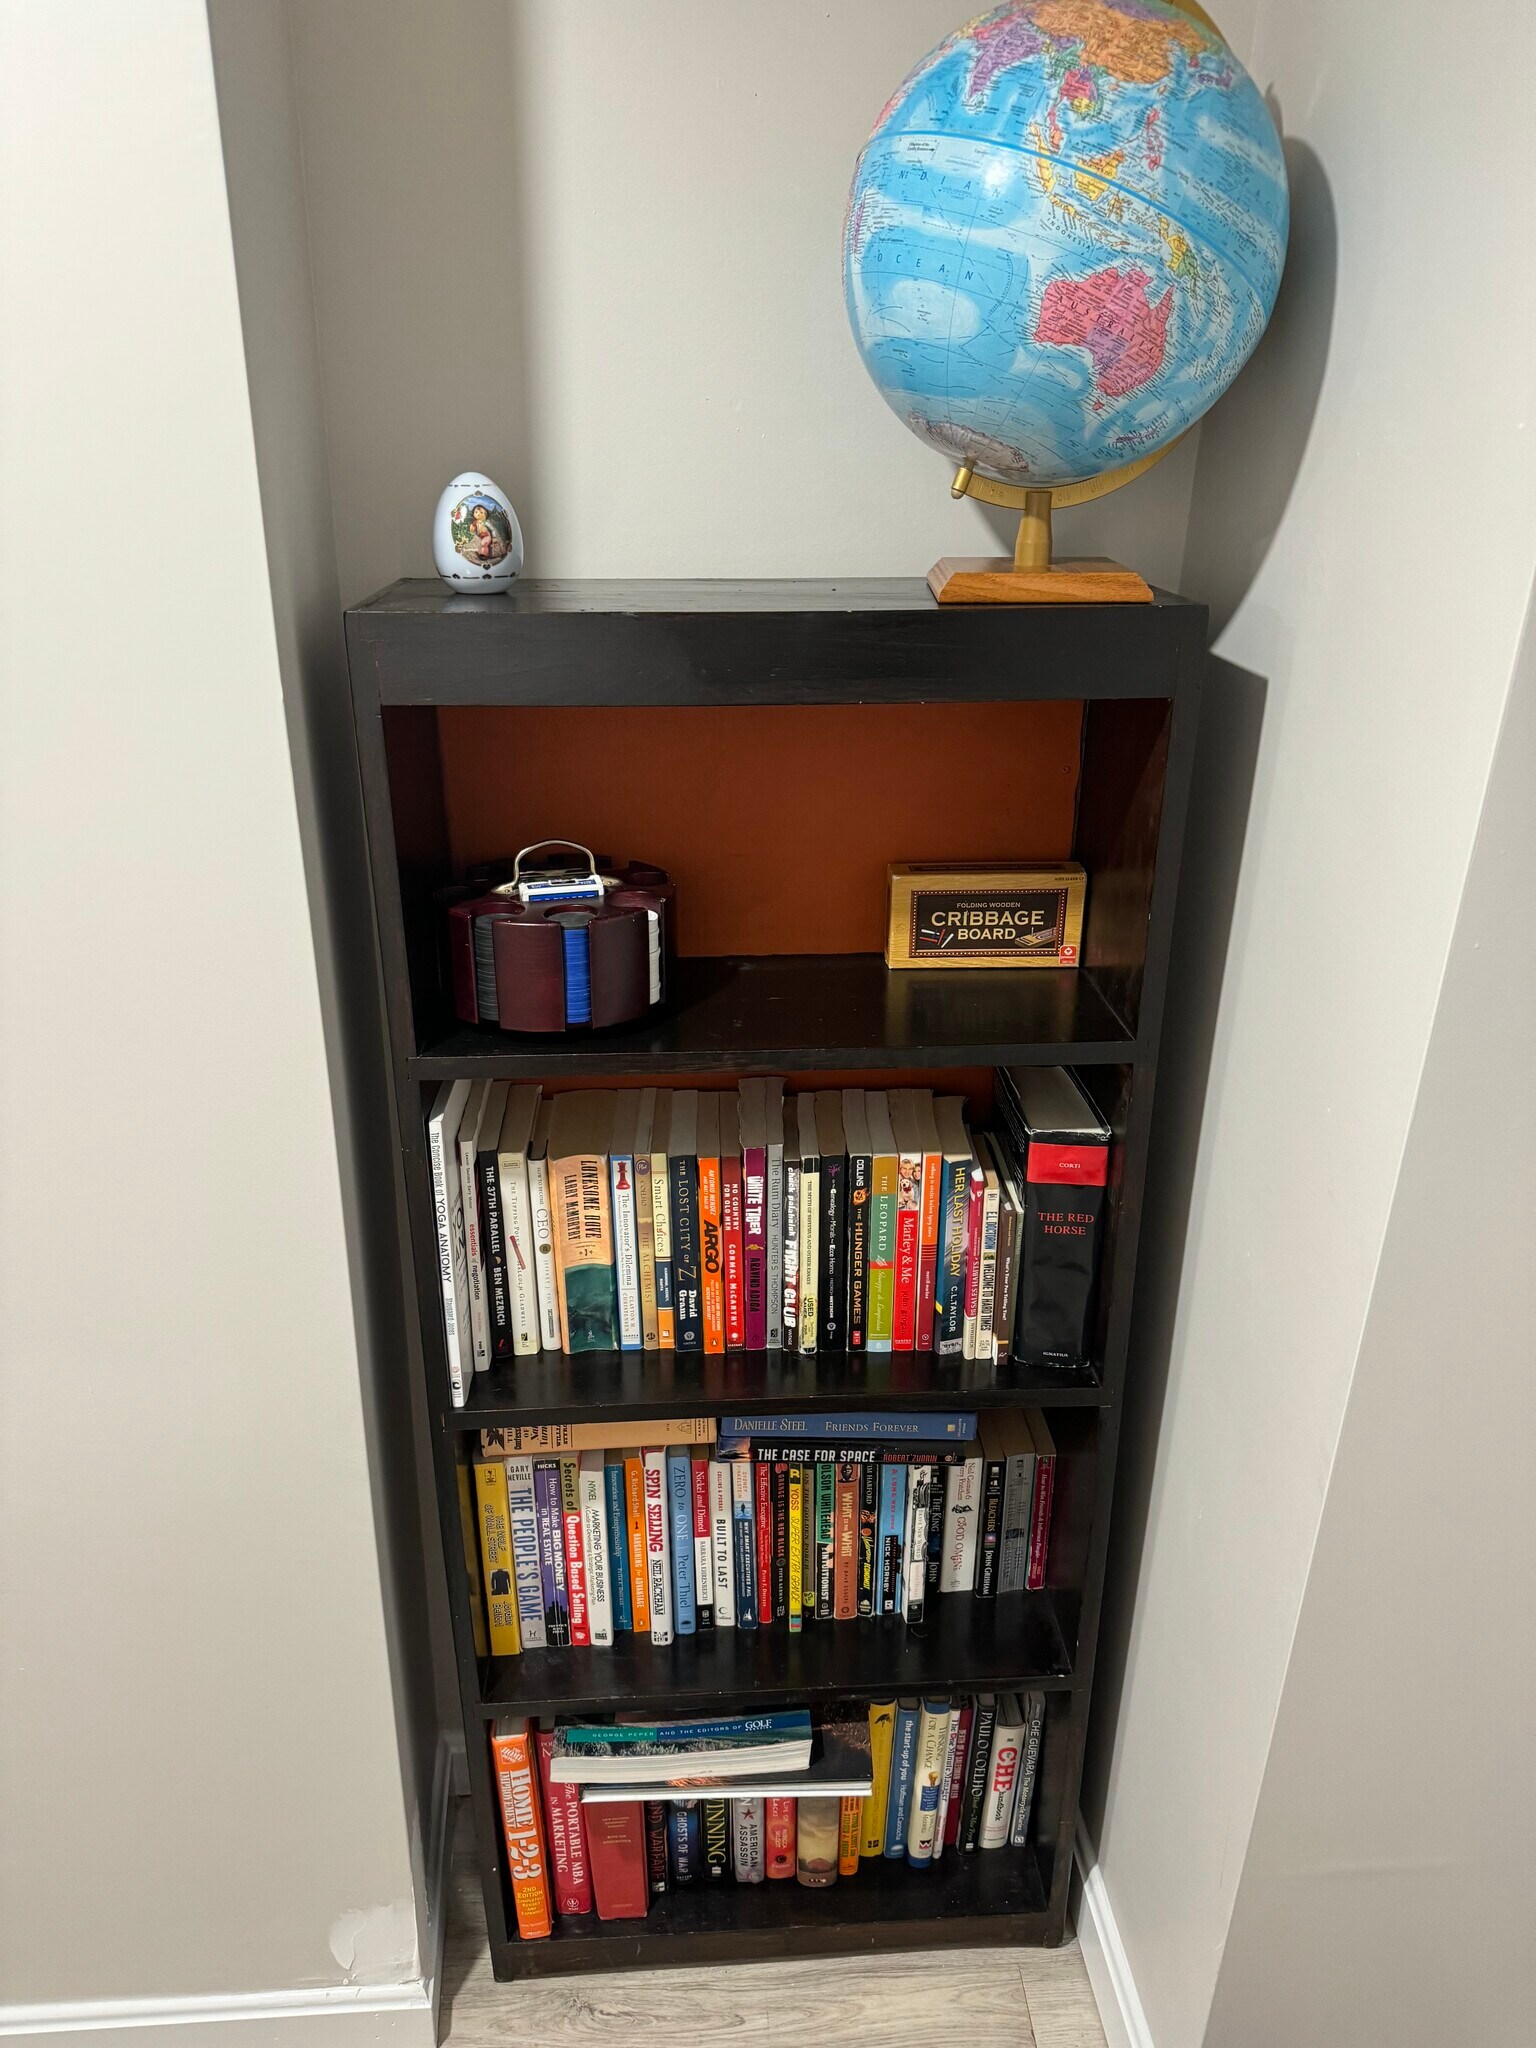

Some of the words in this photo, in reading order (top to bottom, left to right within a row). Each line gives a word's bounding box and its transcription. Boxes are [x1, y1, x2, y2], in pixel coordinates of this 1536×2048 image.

[877, 253, 974, 280] OCEAN
[1057, 296, 1154, 353] AUSTRALIA
[931, 910, 1044, 926] CRIBBAGE
[958, 928, 1016, 940] BOARD
[485, 1166, 495, 1183] THE
[771, 1158, 781, 1176] The
[856, 1160, 864, 1186] COLLINS
[955, 1167, 965, 1192] HER
[487, 1186, 497, 1209] 37TH
[580, 1160, 599, 1210] LONESOME
[678, 1180, 689, 1213] LOST
[732, 1184, 738, 1194] NO
[747, 1175, 764, 1204] WHITE
[771, 1179, 780, 1200] Rum
[622, 1194, 630, 1207] The
[953, 1195, 963, 1223] LAST
[584, 1215, 601, 1238] DOVE
[746, 1206, 762, 1234] TIGER
[769, 1203, 781, 1228] Diary
[879, 1196, 888, 1251] LEOPARD
[1038, 1213, 1064, 1222] THE
[1067, 1213, 1094, 1223] RED
[489, 1212, 500, 1254] PARALLEL
[623, 1210, 632, 1251] Innovator's
[680, 1218, 691, 1250] CITY
[900, 1217, 914, 1253] Marley
[1045, 1225, 1086, 1235] HORSE
[704, 1220, 719, 1273] ARGO
[854, 1223, 863, 1276] HUNGER
[903, 1255, 914, 1264] &
[951, 1227, 962, 1277] HOLIDAY
[624, 1254, 634, 1286] Dilemma
[678, 1265, 696, 1281] Z
[783, 1240, 798, 1284] FIGHT
[901, 1267, 913, 1283] Me
[493, 1267, 502, 1285] BEN
[983, 1264, 994, 1290] WELCOME
[495, 1288, 506, 1325] MEZRICH
[679, 1290, 687, 1320] Grann
[688, 1290, 697, 1317] David
[784, 1288, 798, 1328] CLUB
[854, 1281, 862, 1324] GAMES
[981, 1299, 993, 1313] HARD
[981, 1316, 992, 1331] TIMES
[734, 1419, 777, 1430] DANIELLE
[780, 1419, 807, 1431] STEEL
[825, 1422, 868, 1432] FRIENDS
[873, 1422, 918, 1432] FOREVER
[758, 1449, 778, 1460] THE
[782, 1449, 811, 1461] CASE
[814, 1450, 837, 1461] FOR
[840, 1450, 875, 1462] SPACE
[549, 1478, 558, 1495] How
[564, 1463, 576, 1499] Secrets
[646, 1469, 660, 1499] SPIN
[674, 1466, 686, 1498] ZERO
[695, 1471, 704, 1493] Nickel
[760, 1477, 768, 1501] Effective
[804, 1474, 809, 1484] ON
[510, 1488, 533, 1513] THE
[542, 1508, 549, 1516] in
[565, 1501, 578, 1511] of
[677, 1502, 684, 1510] to
[696, 1495, 705, 1508] and
[790, 1488, 799, 1511] YOSS
[542, 1518, 550, 1537] REAL
[551, 1507, 559, 1528] Make
[647, 1504, 663, 1552] SELLING
[676, 1514, 687, 1540] ONE
[697, 1509, 706, 1532] Dimed
[761, 1502, 769, 1529] Executive
[987, 1499, 997, 1531] BLEACHERS
[552, 1530, 561, 1550] BIG
[567, 1516, 581, 1559] Question
[592, 1509, 602, 1550] MARKETING
[716, 1519, 726, 1546] BUILT
[791, 1517, 799, 1543] SUPER
[512, 1519, 538, 1580] PEOPLE'S
[543, 1539, 552, 1565] ESTATE
[594, 1552, 603, 1570] YOUR
[717, 1550, 727, 1562] TO
[791, 1546, 800, 1572] EXTRA
[984, 1550, 992, 1566] JOHN
[554, 1552, 564, 1591] MONEY
[570, 1562, 584, 1590] Based
[652, 1559, 662, 1577] NEIL
[678, 1555, 689, 1579] Peter
[718, 1566, 728, 1588] LAST
[929, 1562, 938, 1582] JOHN
[596, 1572, 604, 1602] BUSINESS
[791, 1575, 800, 1603] GRANDE
[982, 1568, 992, 1594] GRISHAM
[520, 1585, 542, 1621] GAME
[571, 1592, 585, 1624] Selling
[652, 1578, 665, 1615] RACKHAM
[679, 1583, 691, 1608] Thiel
[744, 1719, 772, 1729] GOLF
[905, 1720, 913, 1731] the
[977, 1712, 993, 1749] PAULO
[901, 1732, 912, 1759] start-up
[900, 1768, 908, 1780] you
[971, 1751, 987, 1797] COELHO
[499, 1772, 516, 1828] IMPROVEMENT
[510, 1767, 533, 1827] HOME
[550, 1796, 558, 1804] IN
[564, 1784, 575, 1799] The
[551, 1808, 568, 1872] MARKETING
[566, 1802, 581, 1858] PORTABLE
[677, 1812, 688, 1842] GHOSTS
[508, 1828, 542, 1879] 1-2-3
[678, 1844, 688, 1853] OF
[740, 1825, 748, 1867] ASSASSIN
[750, 1824, 758, 1867] AMERICAN
[572, 1862, 584, 1885] MBA
[679, 1857, 688, 1873] WAR
[517, 1890, 543, 1898] EDITION
